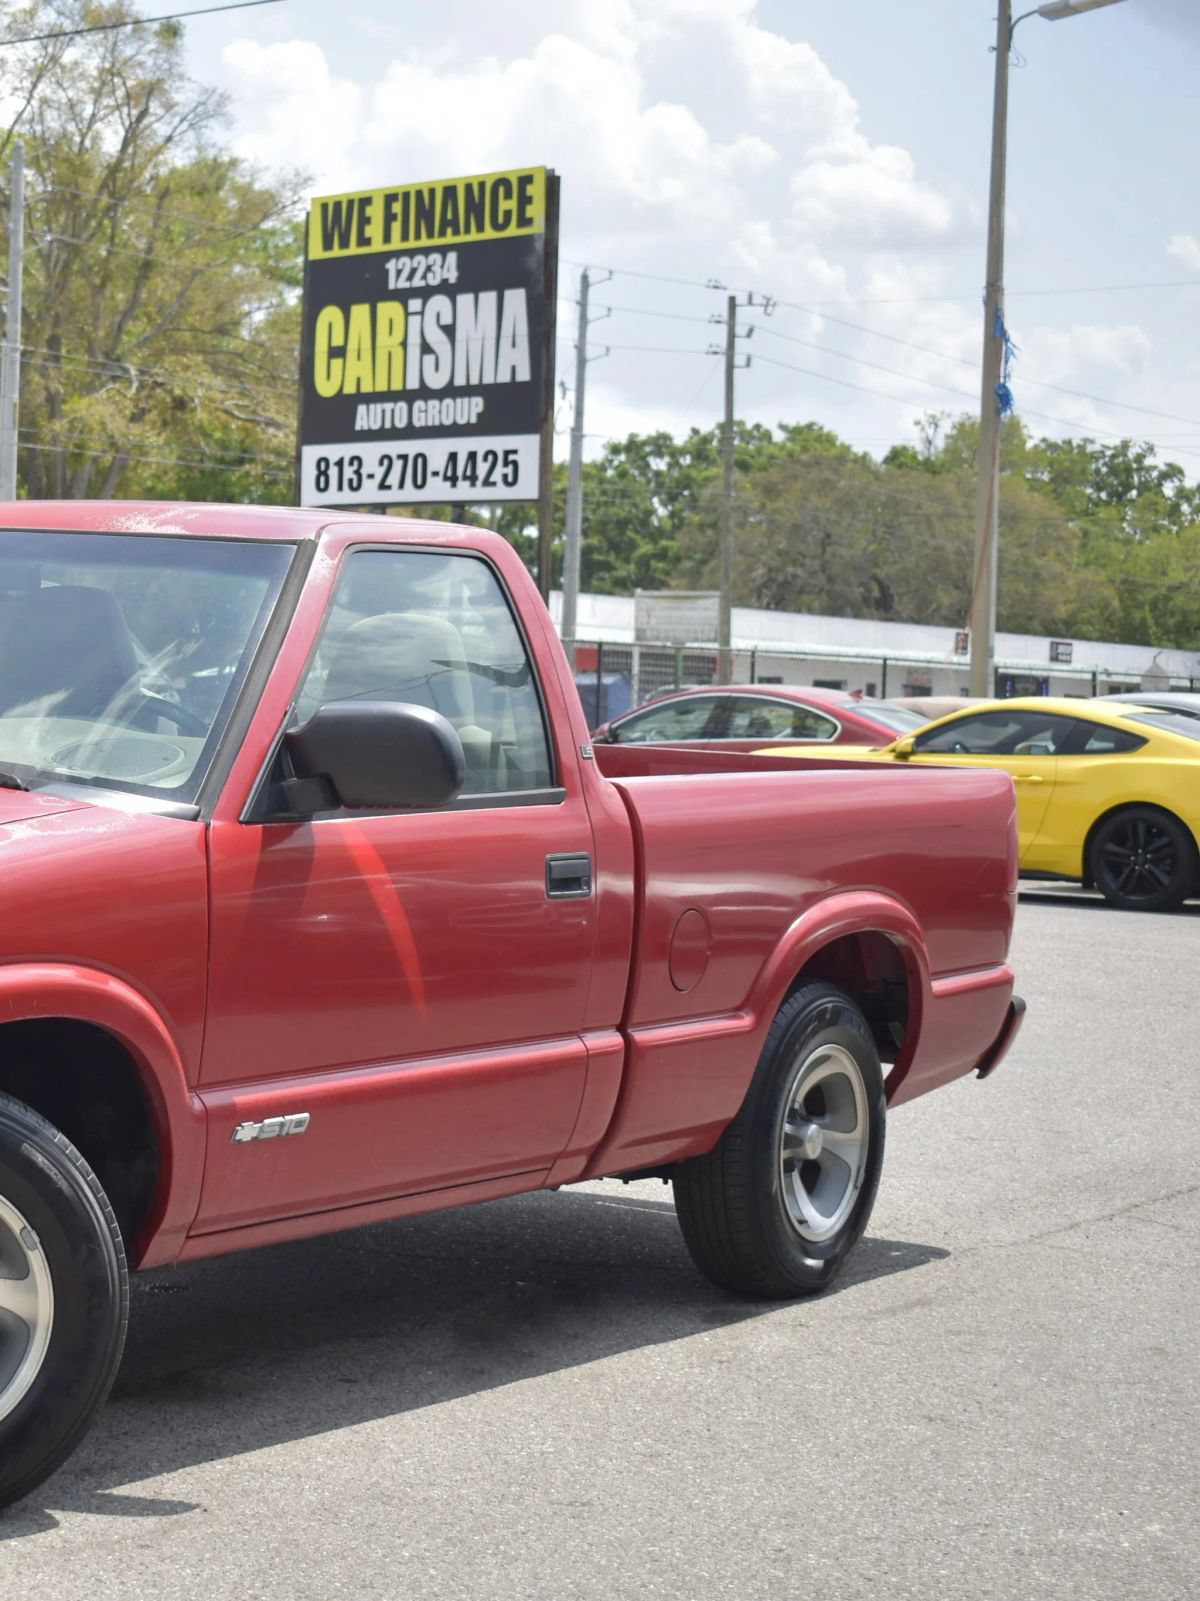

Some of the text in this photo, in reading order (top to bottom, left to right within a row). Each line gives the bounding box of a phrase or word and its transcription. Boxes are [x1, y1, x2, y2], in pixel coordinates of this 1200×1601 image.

[320, 174, 534, 252] WE FINANCE
[385, 251, 459, 290] 12234
[355, 397, 484, 431] AUTO GROUP
[314, 449, 520, 494] 813-270-4425
